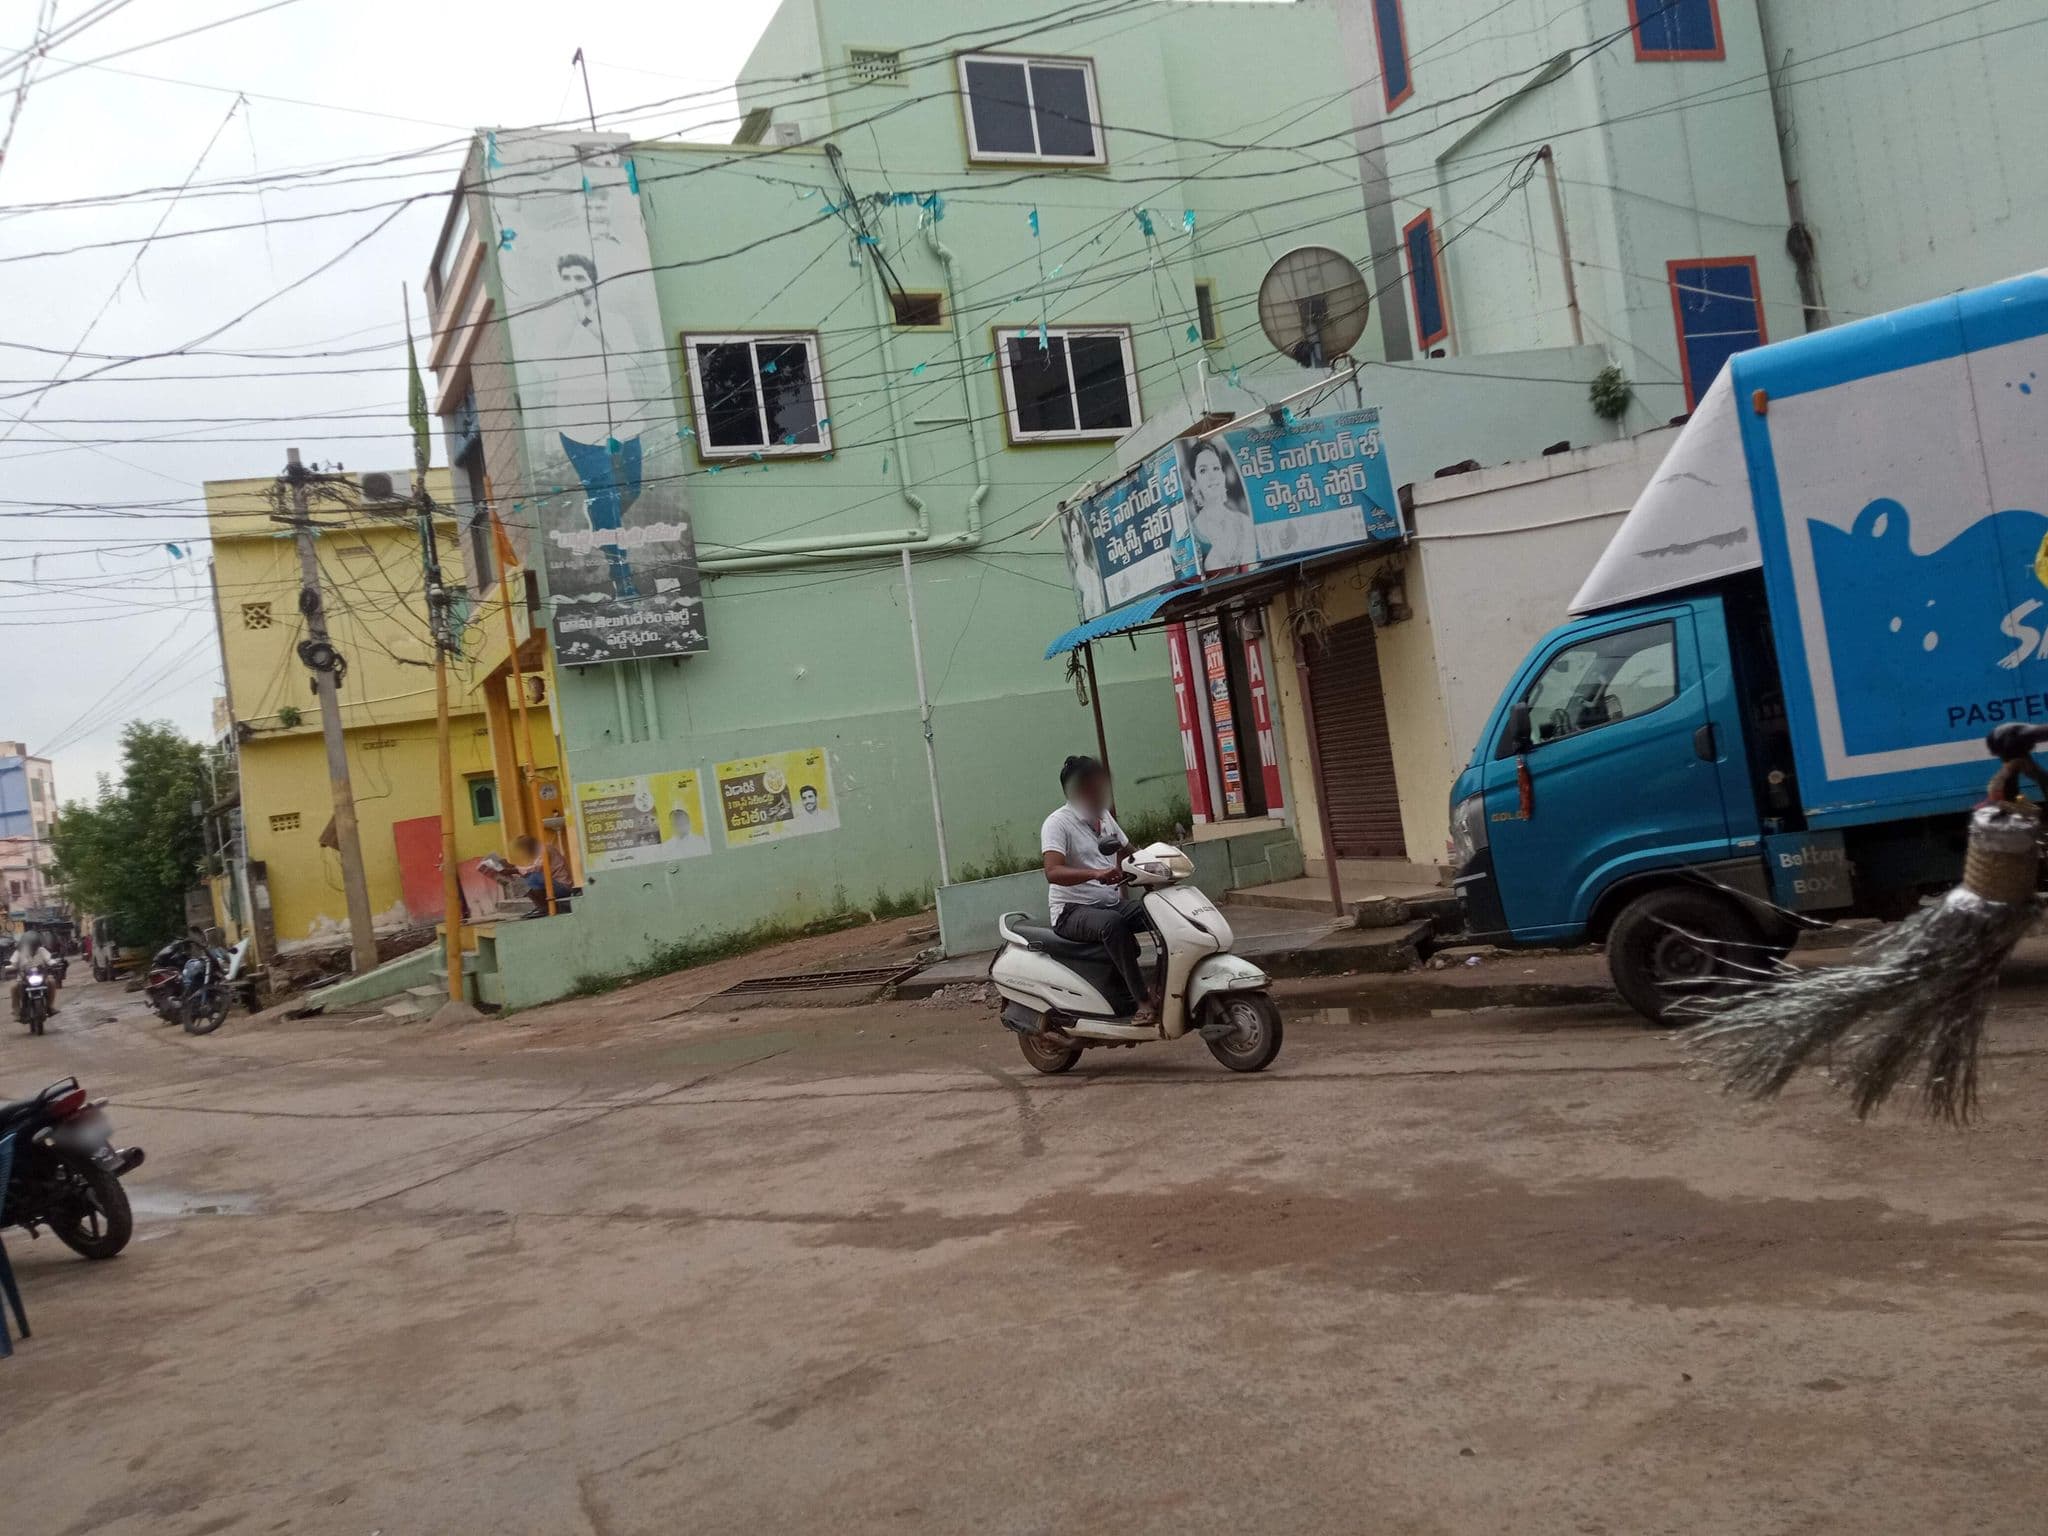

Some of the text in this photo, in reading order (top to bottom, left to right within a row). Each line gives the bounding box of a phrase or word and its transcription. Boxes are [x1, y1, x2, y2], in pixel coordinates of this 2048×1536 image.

[1995, 597, 2048, 670] S
[1170, 637, 1198, 770] ATM
[1249, 645, 1277, 766] ATM
